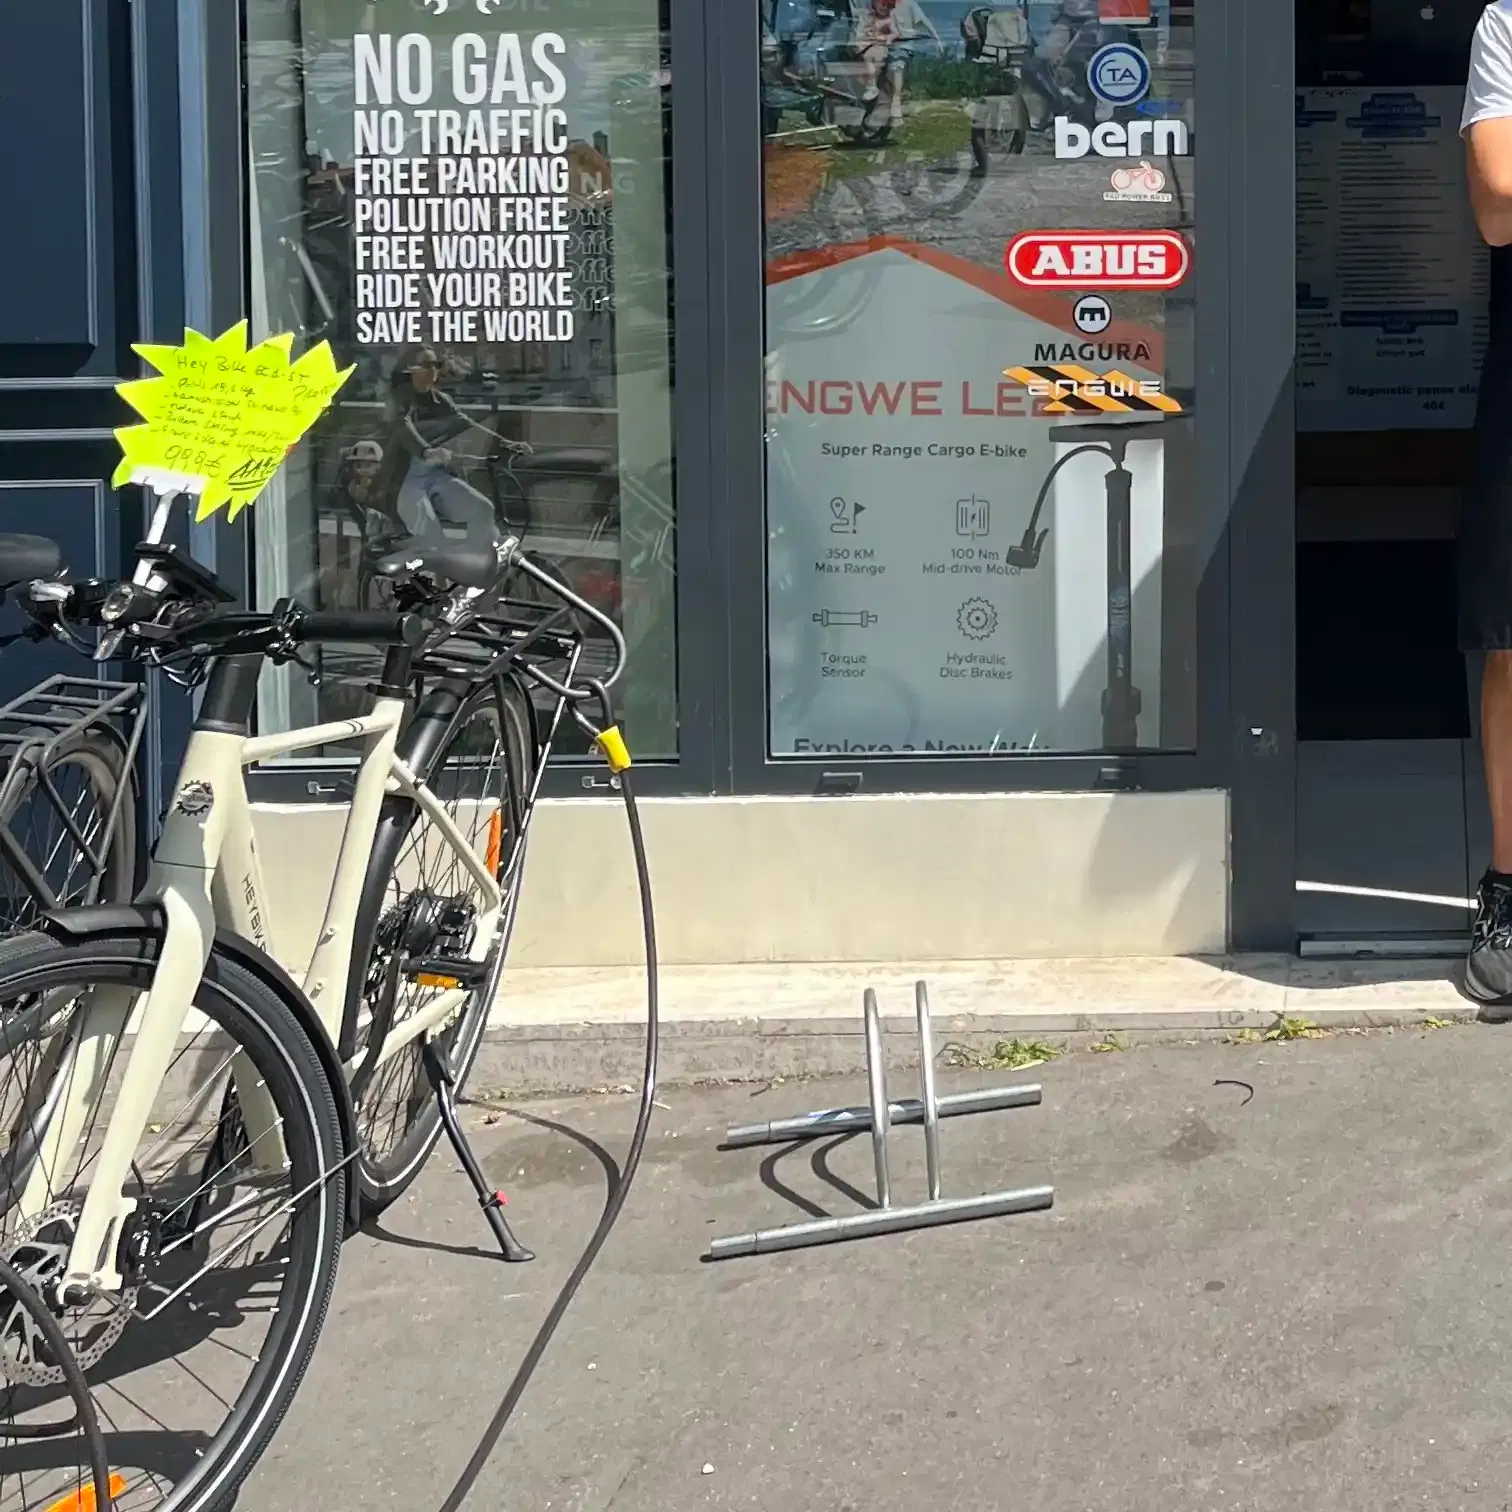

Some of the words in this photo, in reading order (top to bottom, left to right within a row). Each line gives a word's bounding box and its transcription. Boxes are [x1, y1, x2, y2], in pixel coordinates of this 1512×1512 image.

[353, 33, 432, 105] NO
[452, 32, 566, 106] GAS
[353, 110, 403, 155] NO
[414, 109, 568, 155] TRAFFIC
[1054, 116, 1188, 159] bern
[354, 158, 429, 195] FREE
[437, 156, 569, 194] PARKING
[355, 198, 491, 233] POLUTION
[501, 197, 569, 232] FREE
[356, 236, 425, 270] FREE
[432, 234, 570, 269] WORKOUT
[1032, 244, 1168, 276] ABUS
[357, 273, 424, 308] RIDE
[426, 273, 501, 308] YOUR
[509, 272, 573, 308] BIKE
[357, 311, 422, 344] SAVE
[428, 311, 477, 343] THE
[484, 310, 574, 343] WORLD
[1034, 343, 1151, 361] MAGURA
[176, 355, 208, 376] Hey
[821, 443, 869, 458] Super
[872, 444, 923, 459] Range
[927, 444, 976, 459] Cargo
[980, 444, 1028, 459] E-bike
[826, 548, 850, 560] 350
[854, 548, 875, 560] KM
[950, 549, 976, 561] 100
[979, 549, 999, 561] Nm
[815, 563, 843, 575] Max
[847, 563, 886, 577] Range
[922, 562, 983, 575] Mid-drive
[986, 563, 1023, 576] Motor
[820, 652, 867, 667] Torque
[946, 652, 1007, 668] Hydraulic
[821, 667, 866, 679] Sensor
[940, 667, 968, 679] Disc
[971, 667, 1013, 680] Brakes
